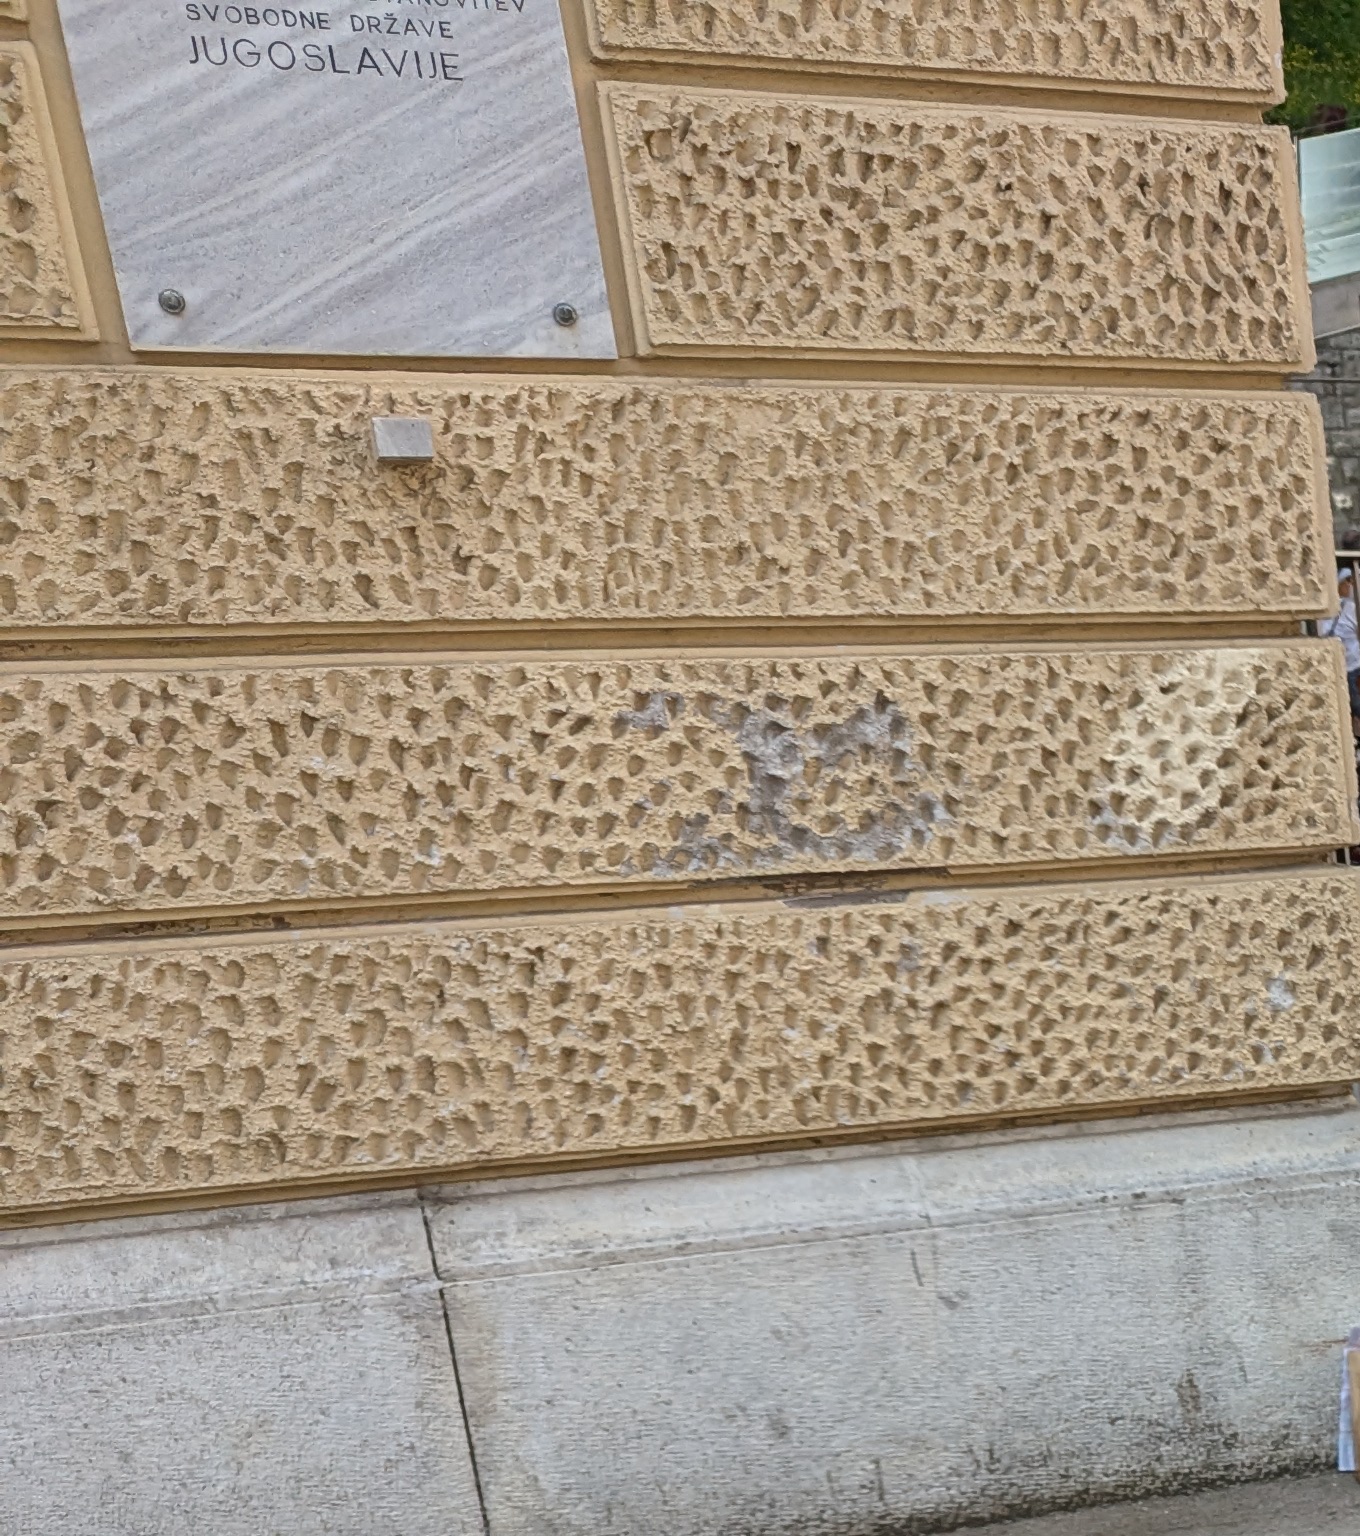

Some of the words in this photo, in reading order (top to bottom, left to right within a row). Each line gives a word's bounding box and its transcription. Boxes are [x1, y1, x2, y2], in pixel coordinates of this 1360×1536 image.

[185, 3, 332, 30] SVOBODNE
[349, 12, 455, 39] DRŽAVE
[188, 35, 464, 82] JUGOSLAVIJE
